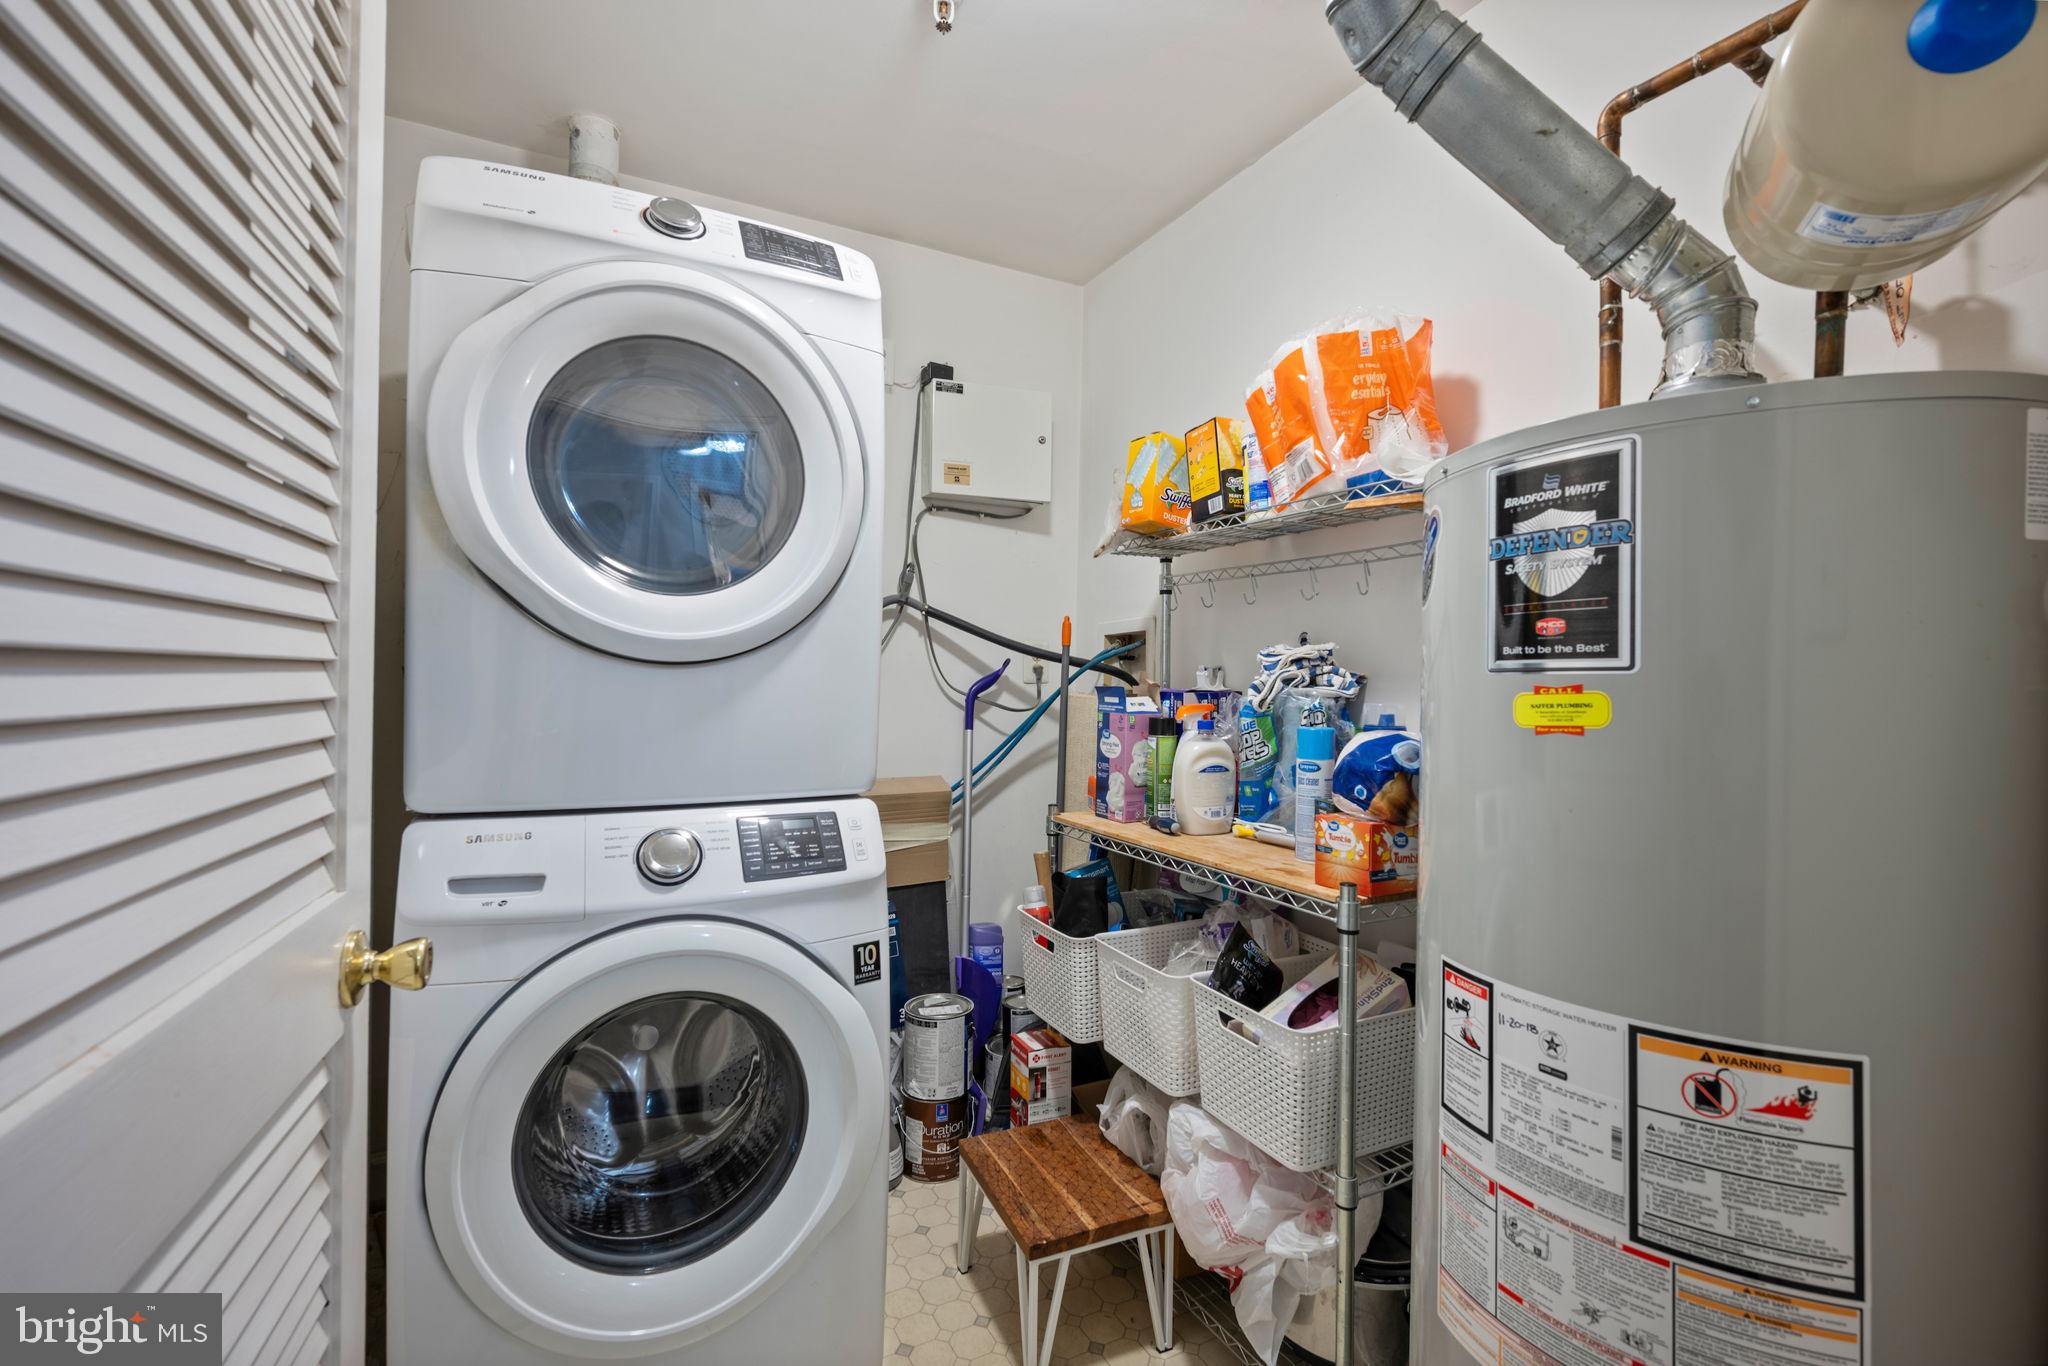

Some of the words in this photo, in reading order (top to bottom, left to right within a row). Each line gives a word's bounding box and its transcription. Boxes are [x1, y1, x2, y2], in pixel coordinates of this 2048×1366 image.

[483, 165, 546, 181] SAMSUNG
[1160, 487, 1192, 509] Swiffe
[1504, 489, 1562, 509] BRADFORD
[1564, 481, 1607, 497] WHITE
[1489, 519, 1634, 561] DEFENDER
[1505, 561, 1545, 575] SAFETY
[1502, 646, 1523, 655] Built
[1524, 646, 1535, 654] to
[1537, 645, 1552, 654] be
[1554, 644, 1573, 653] the
[1576, 643, 1605, 653] Best
[1540, 687, 1576, 695] CALL
[465, 831, 532, 844] SAMSUNG
[1328, 832, 1352, 843] Tumble
[857, 944, 877, 966] 10
[860, 964, 875, 973] YEAR
[1456, 976, 1482, 995] DANGER
[1500, 992, 1532, 1007] AUTOMATIC
[1532, 1002, 1561, 1017] STORAGE
[1562, 1012, 1587, 1025] WATER
[1587, 1019, 1618, 1032] HEATER
[1717, 1055, 1783, 1074] WARNING
[1739, 1116, 1777, 1128] Flammable
[1680, 1121, 1697, 1129] FIRE
[1699, 1126, 1716, 1134] AND
[1717, 1129, 1763, 1144] EXPLOSION
[1764, 1139, 1799, 1150] HAZARD
